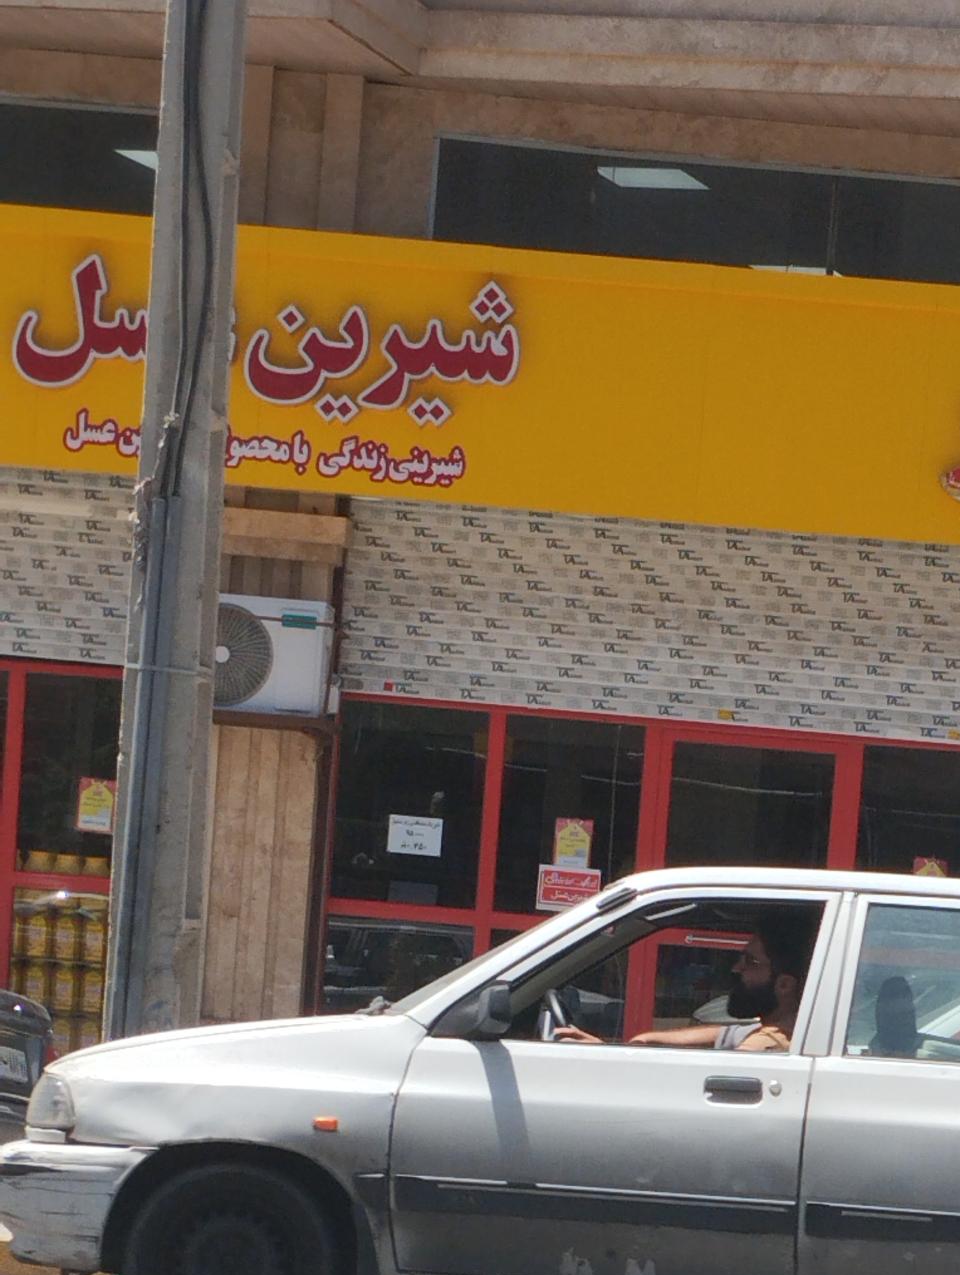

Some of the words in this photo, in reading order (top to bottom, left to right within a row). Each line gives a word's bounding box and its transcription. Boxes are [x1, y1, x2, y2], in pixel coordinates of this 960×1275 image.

[12, 253, 236, 388] سل
[244, 280, 520, 426] شیرین
[63, 408, 118, 452] عسل
[291, 430, 311, 475] با
[317, 435, 389, 482] زندگی
[388, 445, 466, 488] شیرینی
